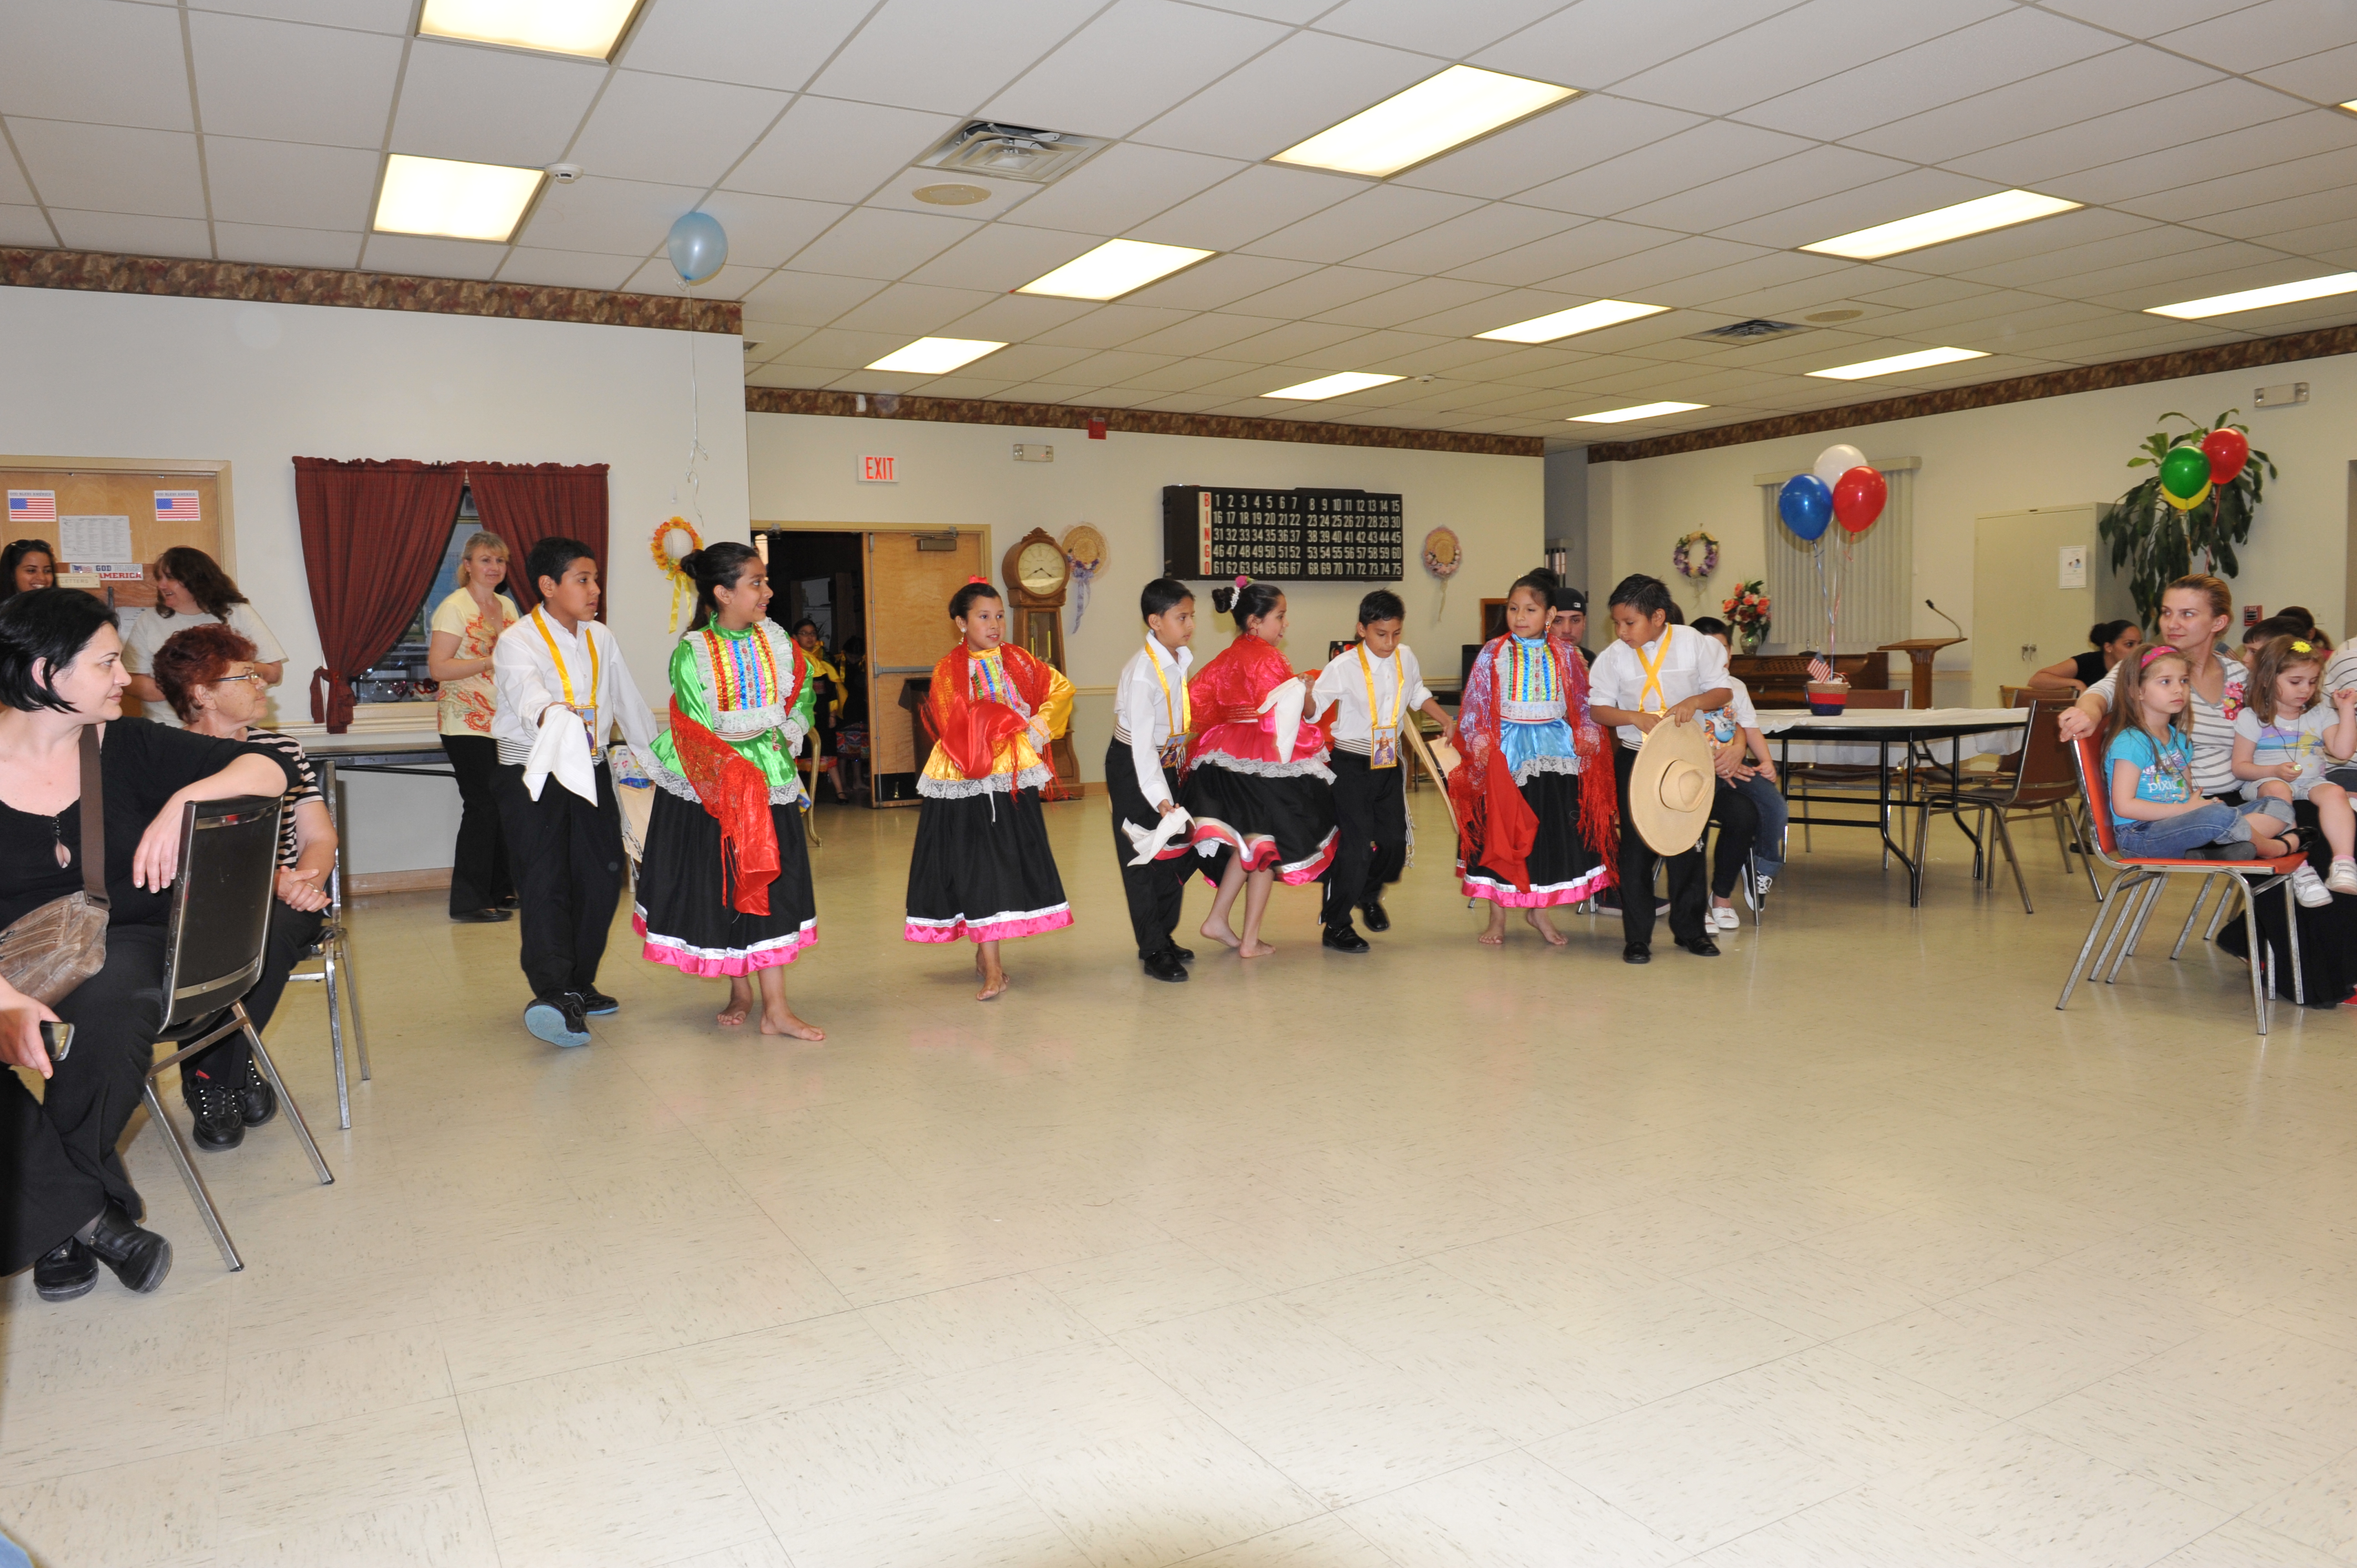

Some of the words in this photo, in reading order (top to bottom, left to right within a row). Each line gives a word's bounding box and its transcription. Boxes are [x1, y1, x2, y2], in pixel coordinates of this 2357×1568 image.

[866, 457, 894, 480] EXIT
[1216, 494, 1219, 507] 1
[1228, 494, 1234, 507] 2
[1241, 495, 1247, 508] 3
[1254, 496, 1260, 508] 4
[1266, 496, 1273, 508] 5
[1279, 497, 1285, 509] 6
[1291, 497, 1297, 509] 7
[1309, 498, 1315, 510] 8
[1321, 498, 1327, 510] 9
[1332, 499, 1341, 511] 10
[1345, 499, 1352, 511] 11
[1356, 499, 1365, 512] 12
[1368, 500, 1376, 512] 13
[1380, 500, 1388, 512] 14
[1391, 500, 1400, 512] 15
[1213, 511, 1223, 524] 16
[1227, 512, 1236, 524] 17
[1239, 512, 1249, 524] 18
[1252, 512, 1262, 525] 19
[1264, 513, 1275, 525] 20
[1278, 513, 1288, 525] 21
[1289, 514, 1300, 525] 22
[1307, 514, 1317, 527] 23
[1319, 515, 1329, 527] 24
[1331, 515, 1342, 527] 25
[1343, 515, 1354, 527] 26
[1356, 515, 1365, 527] 27
[1367, 515, 1377, 527] 28
[1379, 516, 1389, 528] 29
[1391, 516, 1401, 528] 30
[1213, 528, 1223, 540] 31
[1226, 528, 1237, 541] 32
[1239, 529, 1250, 541] 33
[1252, 529, 1263, 541] 34
[1264, 529, 1276, 541] 35
[1278, 529, 1288, 542] 36
[1290, 530, 1300, 542] 37
[1307, 530, 1318, 542] 38
[1320, 530, 1330, 543] 39
[1332, 530, 1342, 543] 40
[1344, 531, 1354, 543] 41
[1356, 532, 1366, 543] 42
[1367, 532, 1377, 543] 43
[1379, 532, 1390, 543] 44
[1391, 532, 1401, 543] 45
[1213, 545, 1224, 557] 46
[1226, 545, 1237, 558] 47
[1239, 545, 1250, 558] 48
[1252, 545, 1263, 558] 49
[1265, 545, 1275, 558] 50
[1278, 546, 1288, 558] 51
[1289, 546, 1300, 558] 52
[1307, 546, 1318, 559] 53
[1320, 546, 1330, 559] 54
[1332, 547, 1342, 559] 55
[1344, 547, 1355, 559] 56
[1356, 547, 1366, 559] 57
[1367, 547, 1378, 559] 58
[1380, 547, 1390, 559] 59
[1391, 547, 1402, 559] 60
[1213, 561, 1224, 574] 61
[1226, 561, 1238, 574] 62
[1239, 561, 1250, 574] 63
[1252, 562, 1264, 574] 64
[1265, 562, 1277, 574] 65
[1278, 562, 1289, 574] 66
[1290, 562, 1301, 574] 67
[1308, 563, 1319, 575] 68
[1320, 563, 1331, 575] 69
[1332, 563, 1343, 575] 70
[1346, 563, 1354, 575] 71
[1357, 563, 1366, 575] 72
[1368, 563, 1378, 575] 73
[1380, 563, 1390, 575] 74
[1391, 563, 1402, 575] 75
[2148, 778, 2179, 793] pixie
